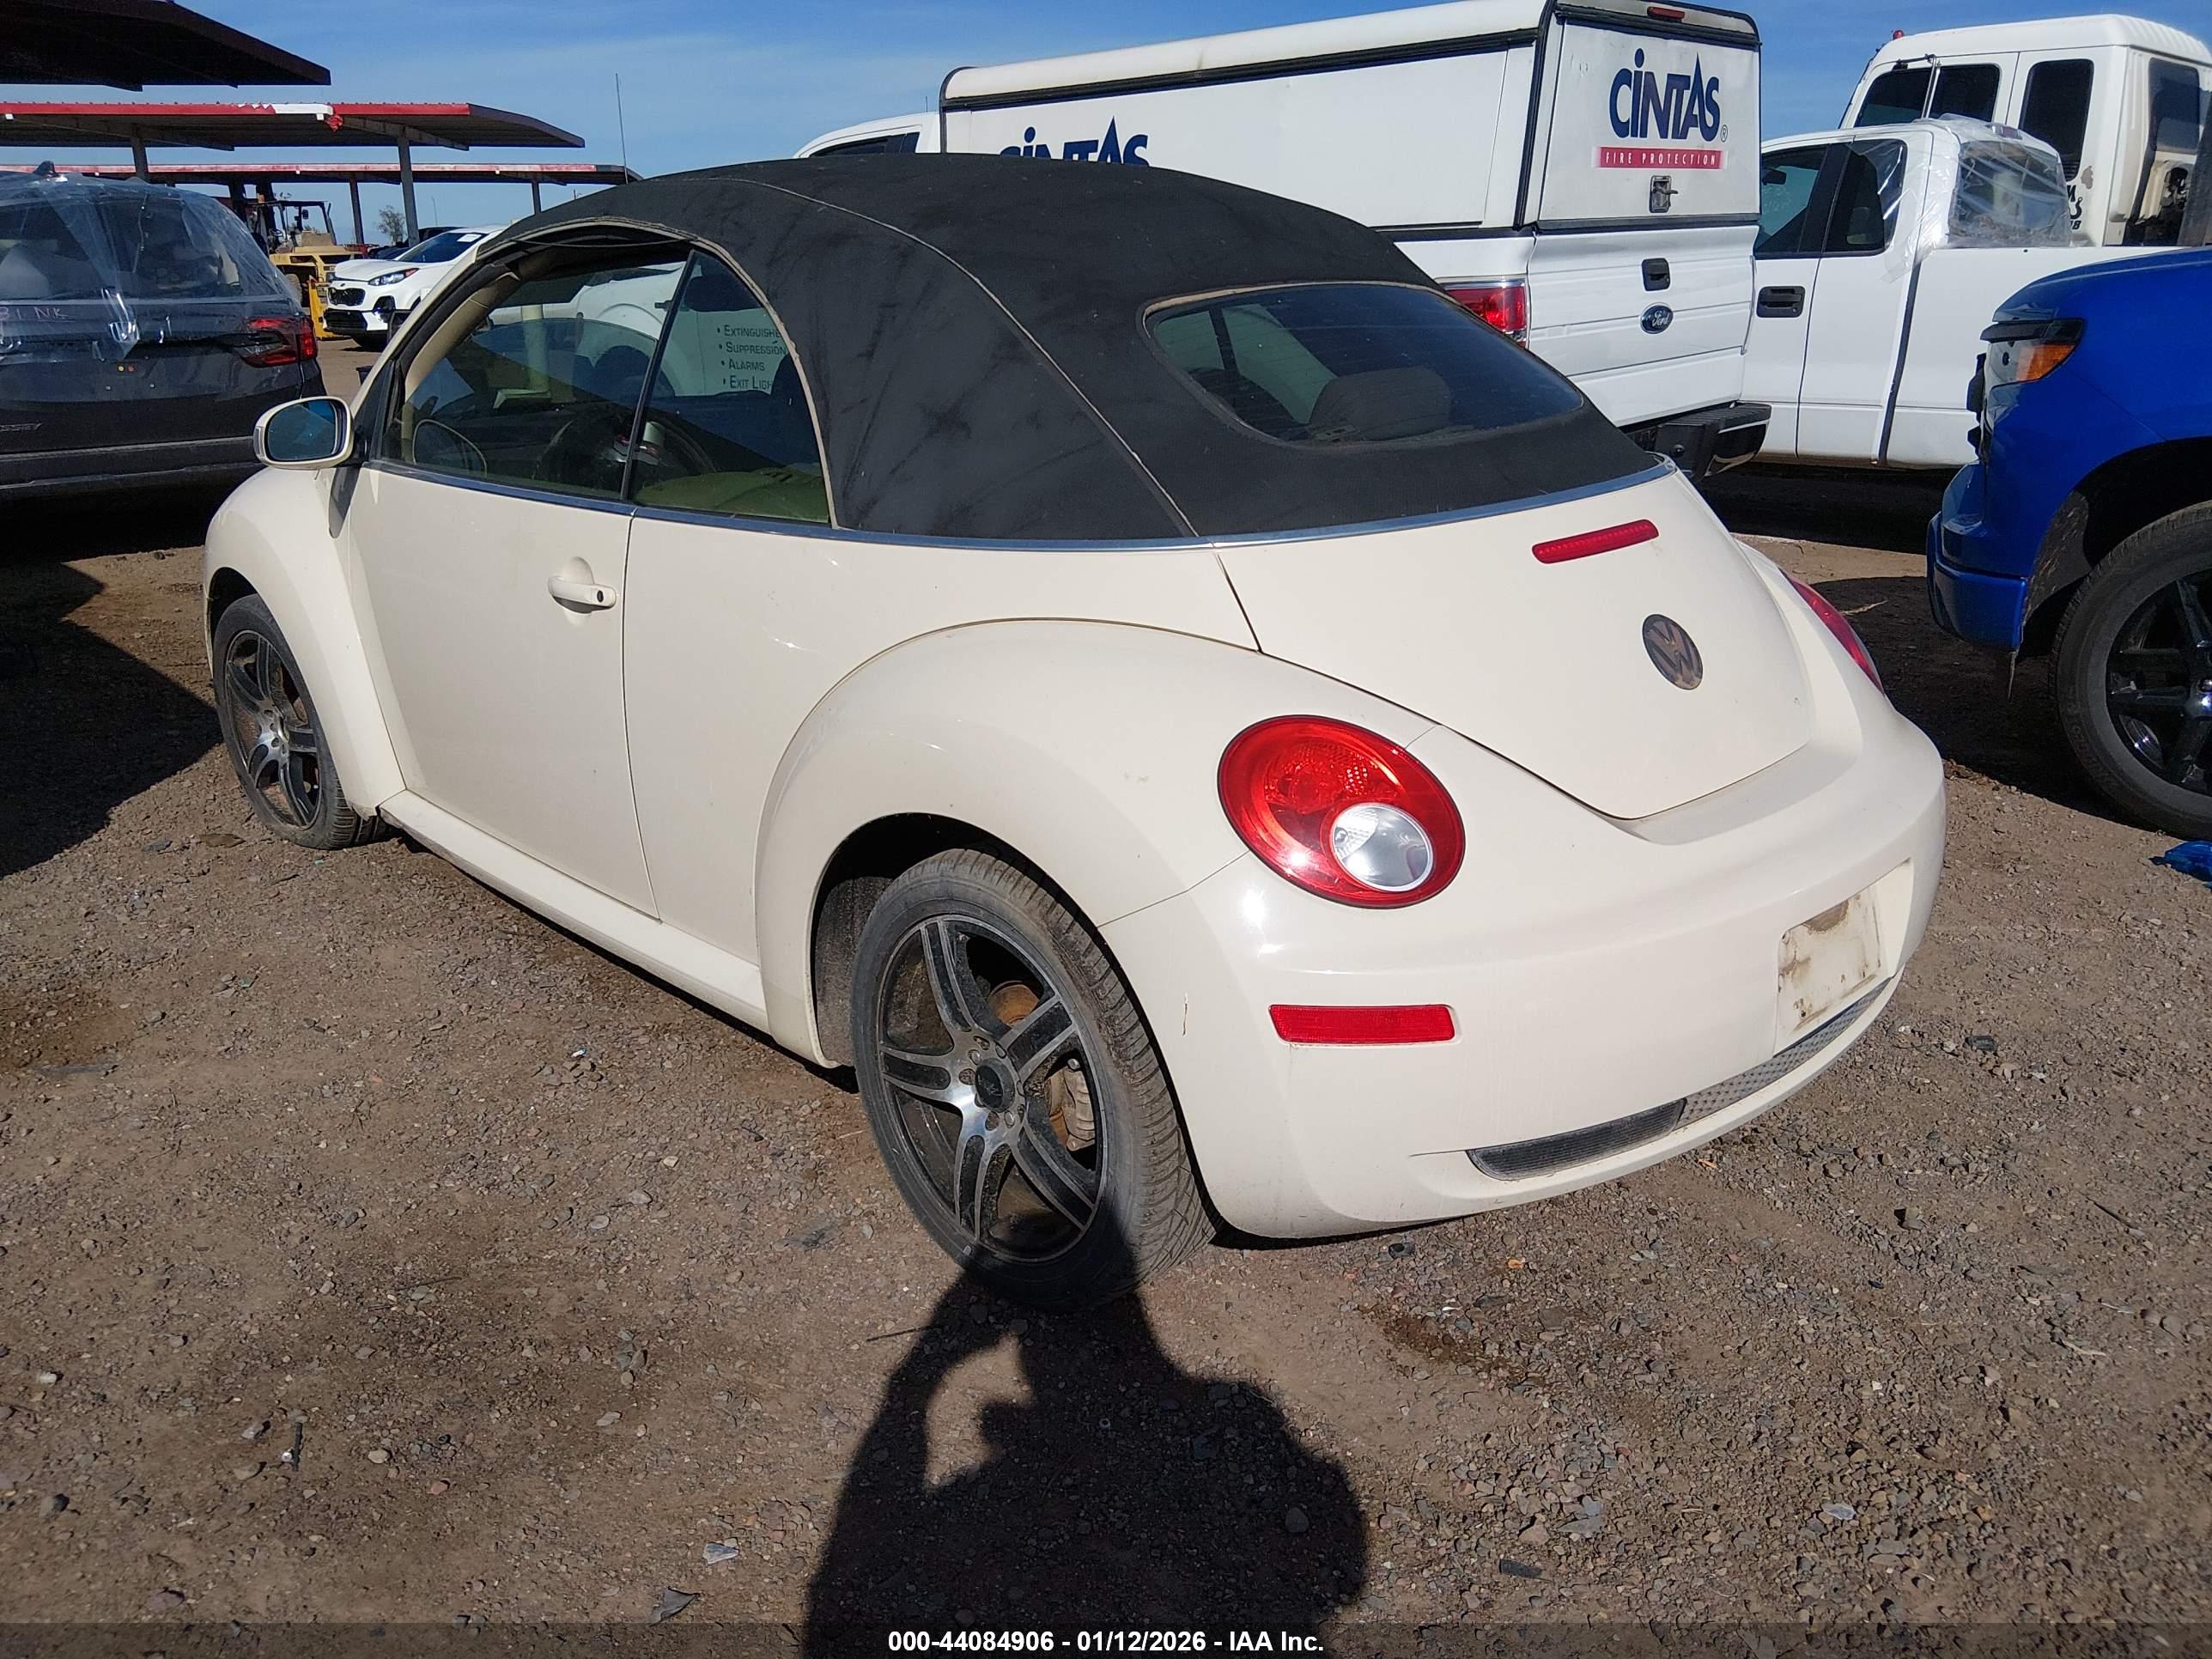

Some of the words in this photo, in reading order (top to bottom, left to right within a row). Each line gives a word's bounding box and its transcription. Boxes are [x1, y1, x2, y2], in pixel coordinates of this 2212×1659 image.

[1606, 152, 1632, 164] FIRE
[1642, 153, 1716, 166] PROTECTION
[726, 342, 786, 355] SUPPRESSION
[729, 359, 765, 371] ALARMS
[730, 375, 749, 388] EXIT
